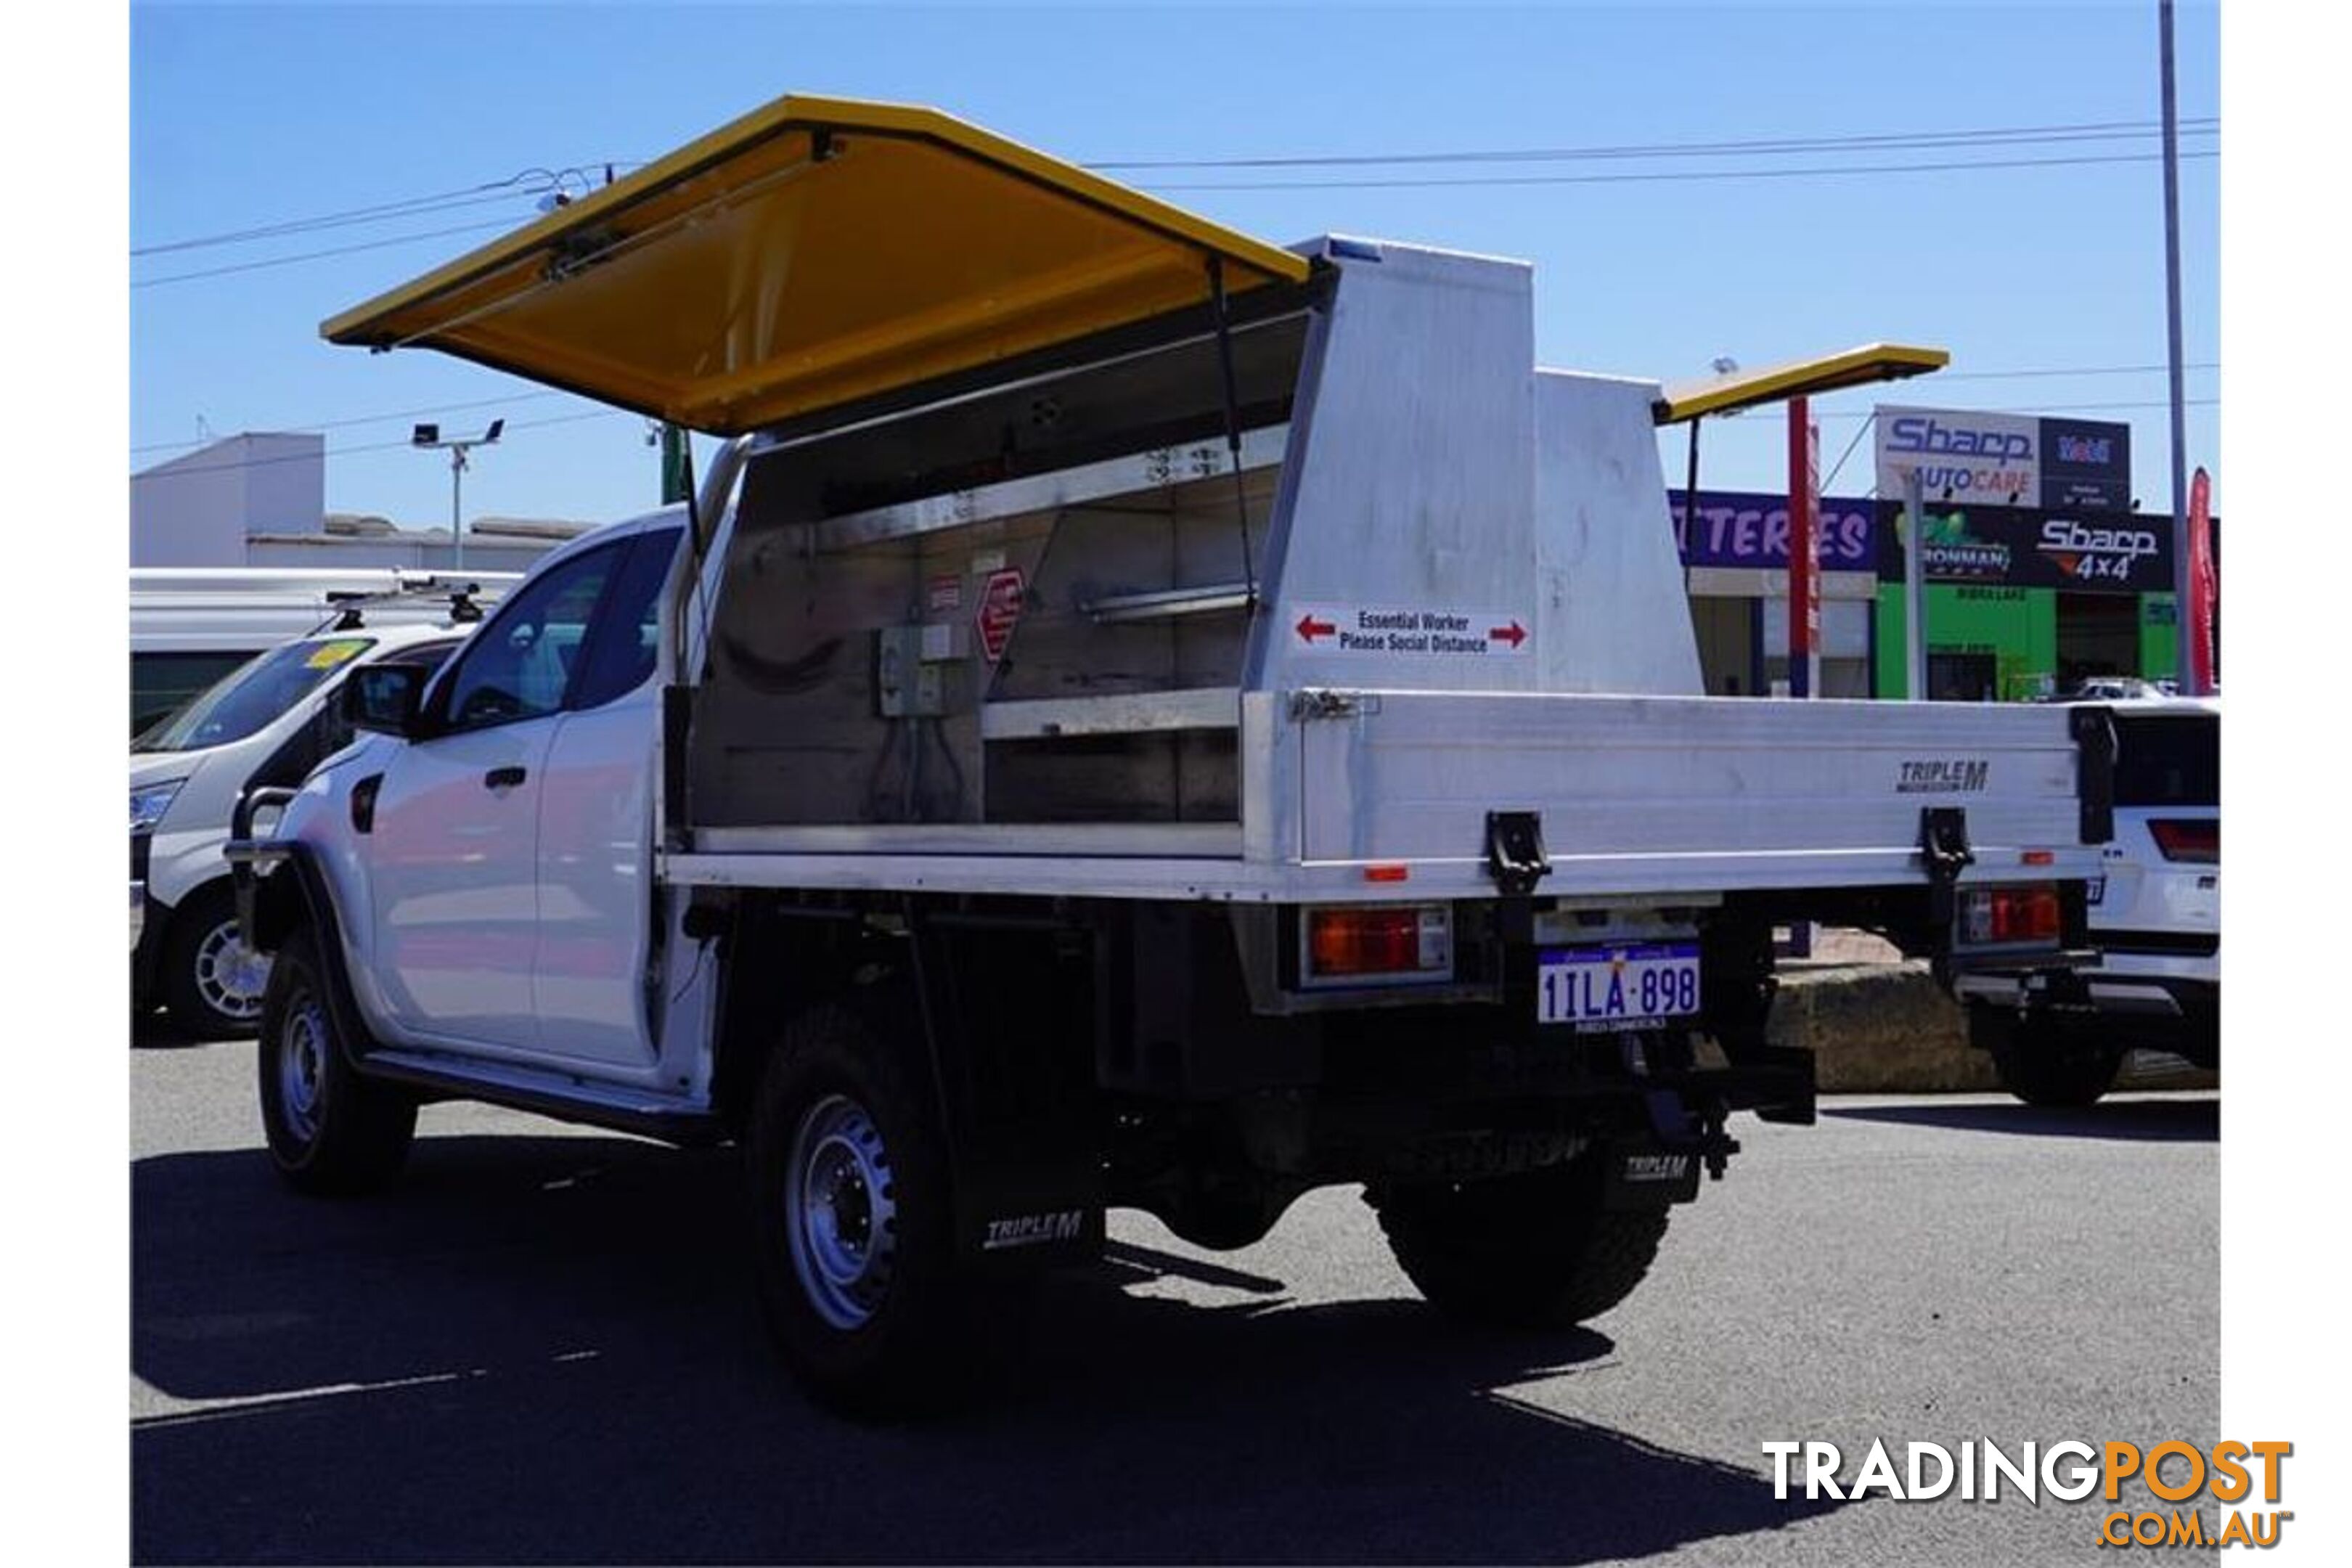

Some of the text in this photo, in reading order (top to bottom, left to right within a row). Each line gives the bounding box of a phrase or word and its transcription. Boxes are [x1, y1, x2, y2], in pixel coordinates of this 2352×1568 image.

[1886, 419, 2033, 467] Sharp
[2037, 520, 2159, 560] Sharp
[1924, 548, 2002, 566] RONMAN
[2076, 555, 2128, 579] 4x4
[1357, 611, 1469, 631] Essential Worker
[1340, 632, 1487, 653] Please Social Distance
